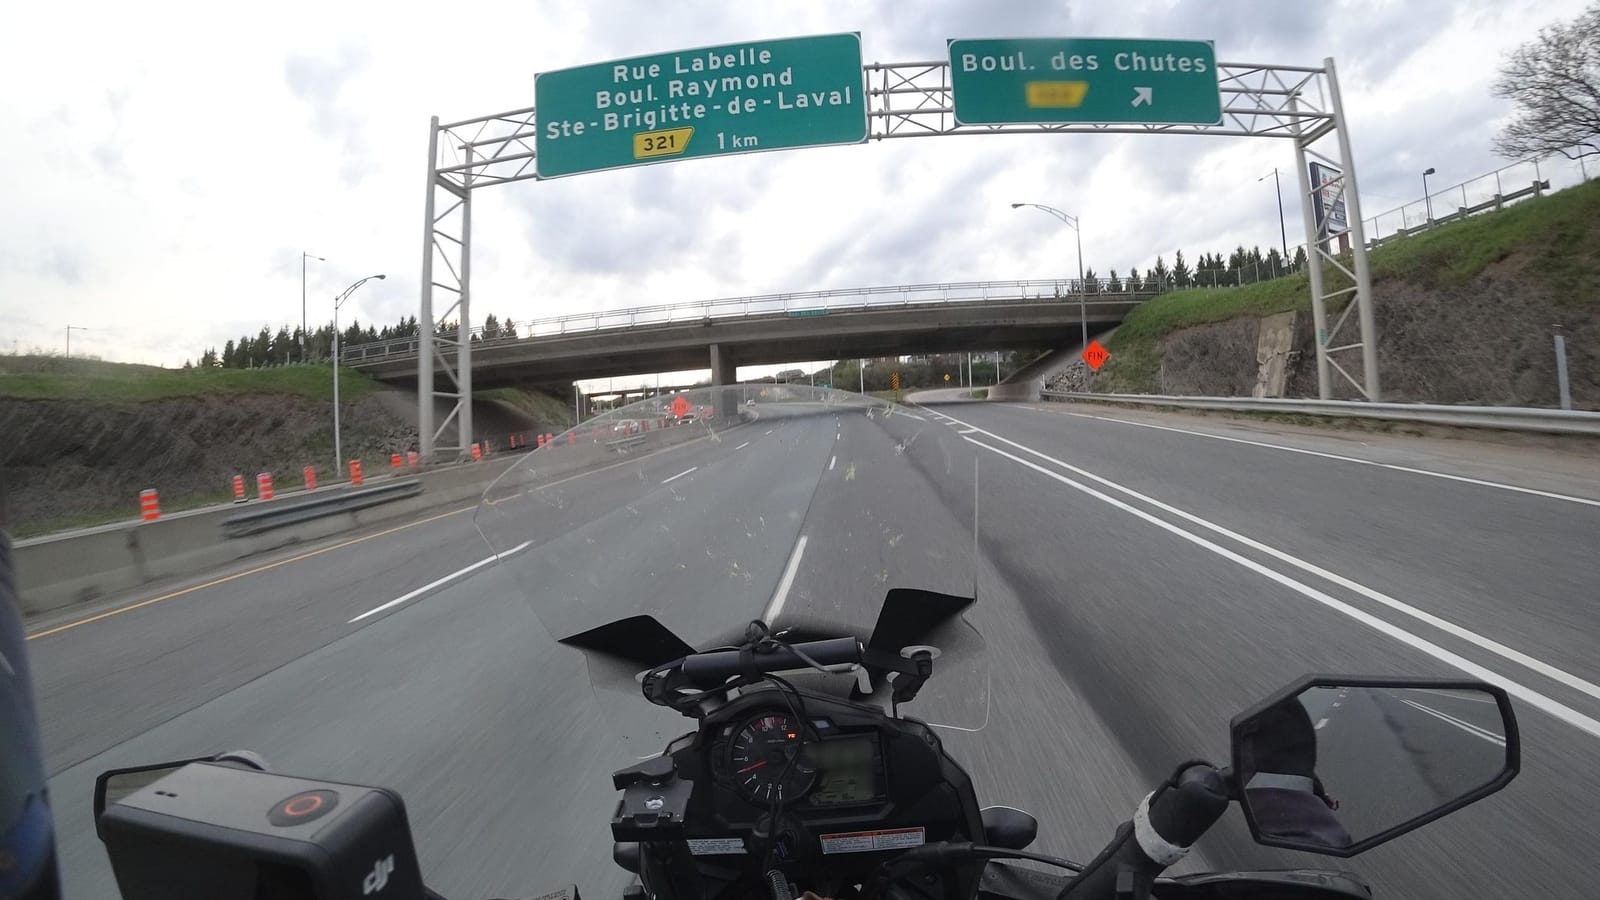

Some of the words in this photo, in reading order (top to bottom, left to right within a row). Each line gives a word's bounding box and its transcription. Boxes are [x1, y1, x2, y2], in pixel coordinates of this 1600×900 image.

[614, 63, 661, 83] Rue
[675, 48, 772, 74] Labelle
[962, 52, 1036, 72] Boul.
[1051, 51, 1099, 71] des
[1114, 52, 1207, 73] Chutes
[596, 84, 659, 109] Boul.
[669, 67, 793, 98] Raymond
[643, 135, 676, 151] 321
[717, 132, 726, 149] 1
[732, 133, 759, 148] km
[1087, 351, 1104, 361] FIN
